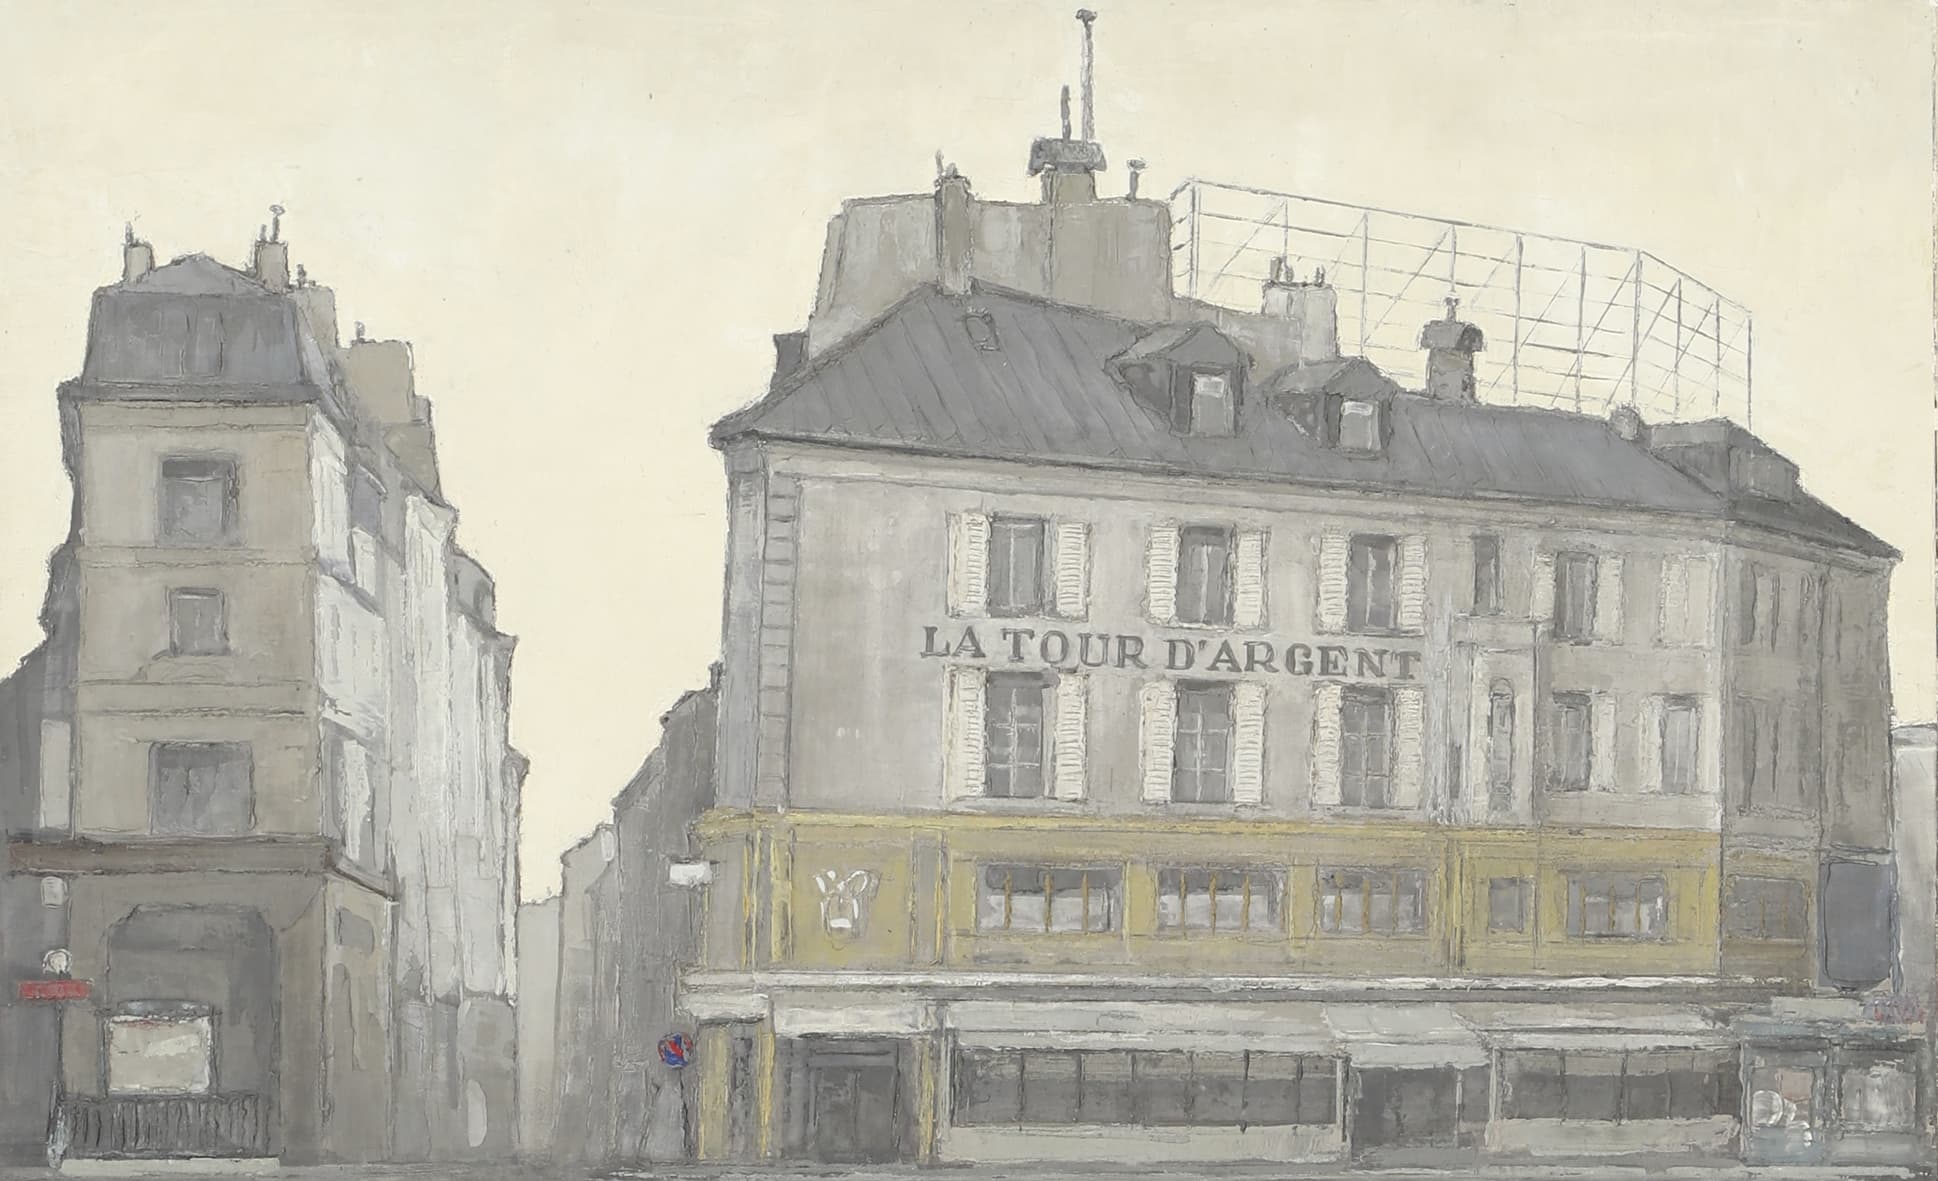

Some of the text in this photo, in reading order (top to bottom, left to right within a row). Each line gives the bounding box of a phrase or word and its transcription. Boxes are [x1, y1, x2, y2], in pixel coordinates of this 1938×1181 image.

[920, 625, 1422, 680] LA TOUR D'ARGENT
